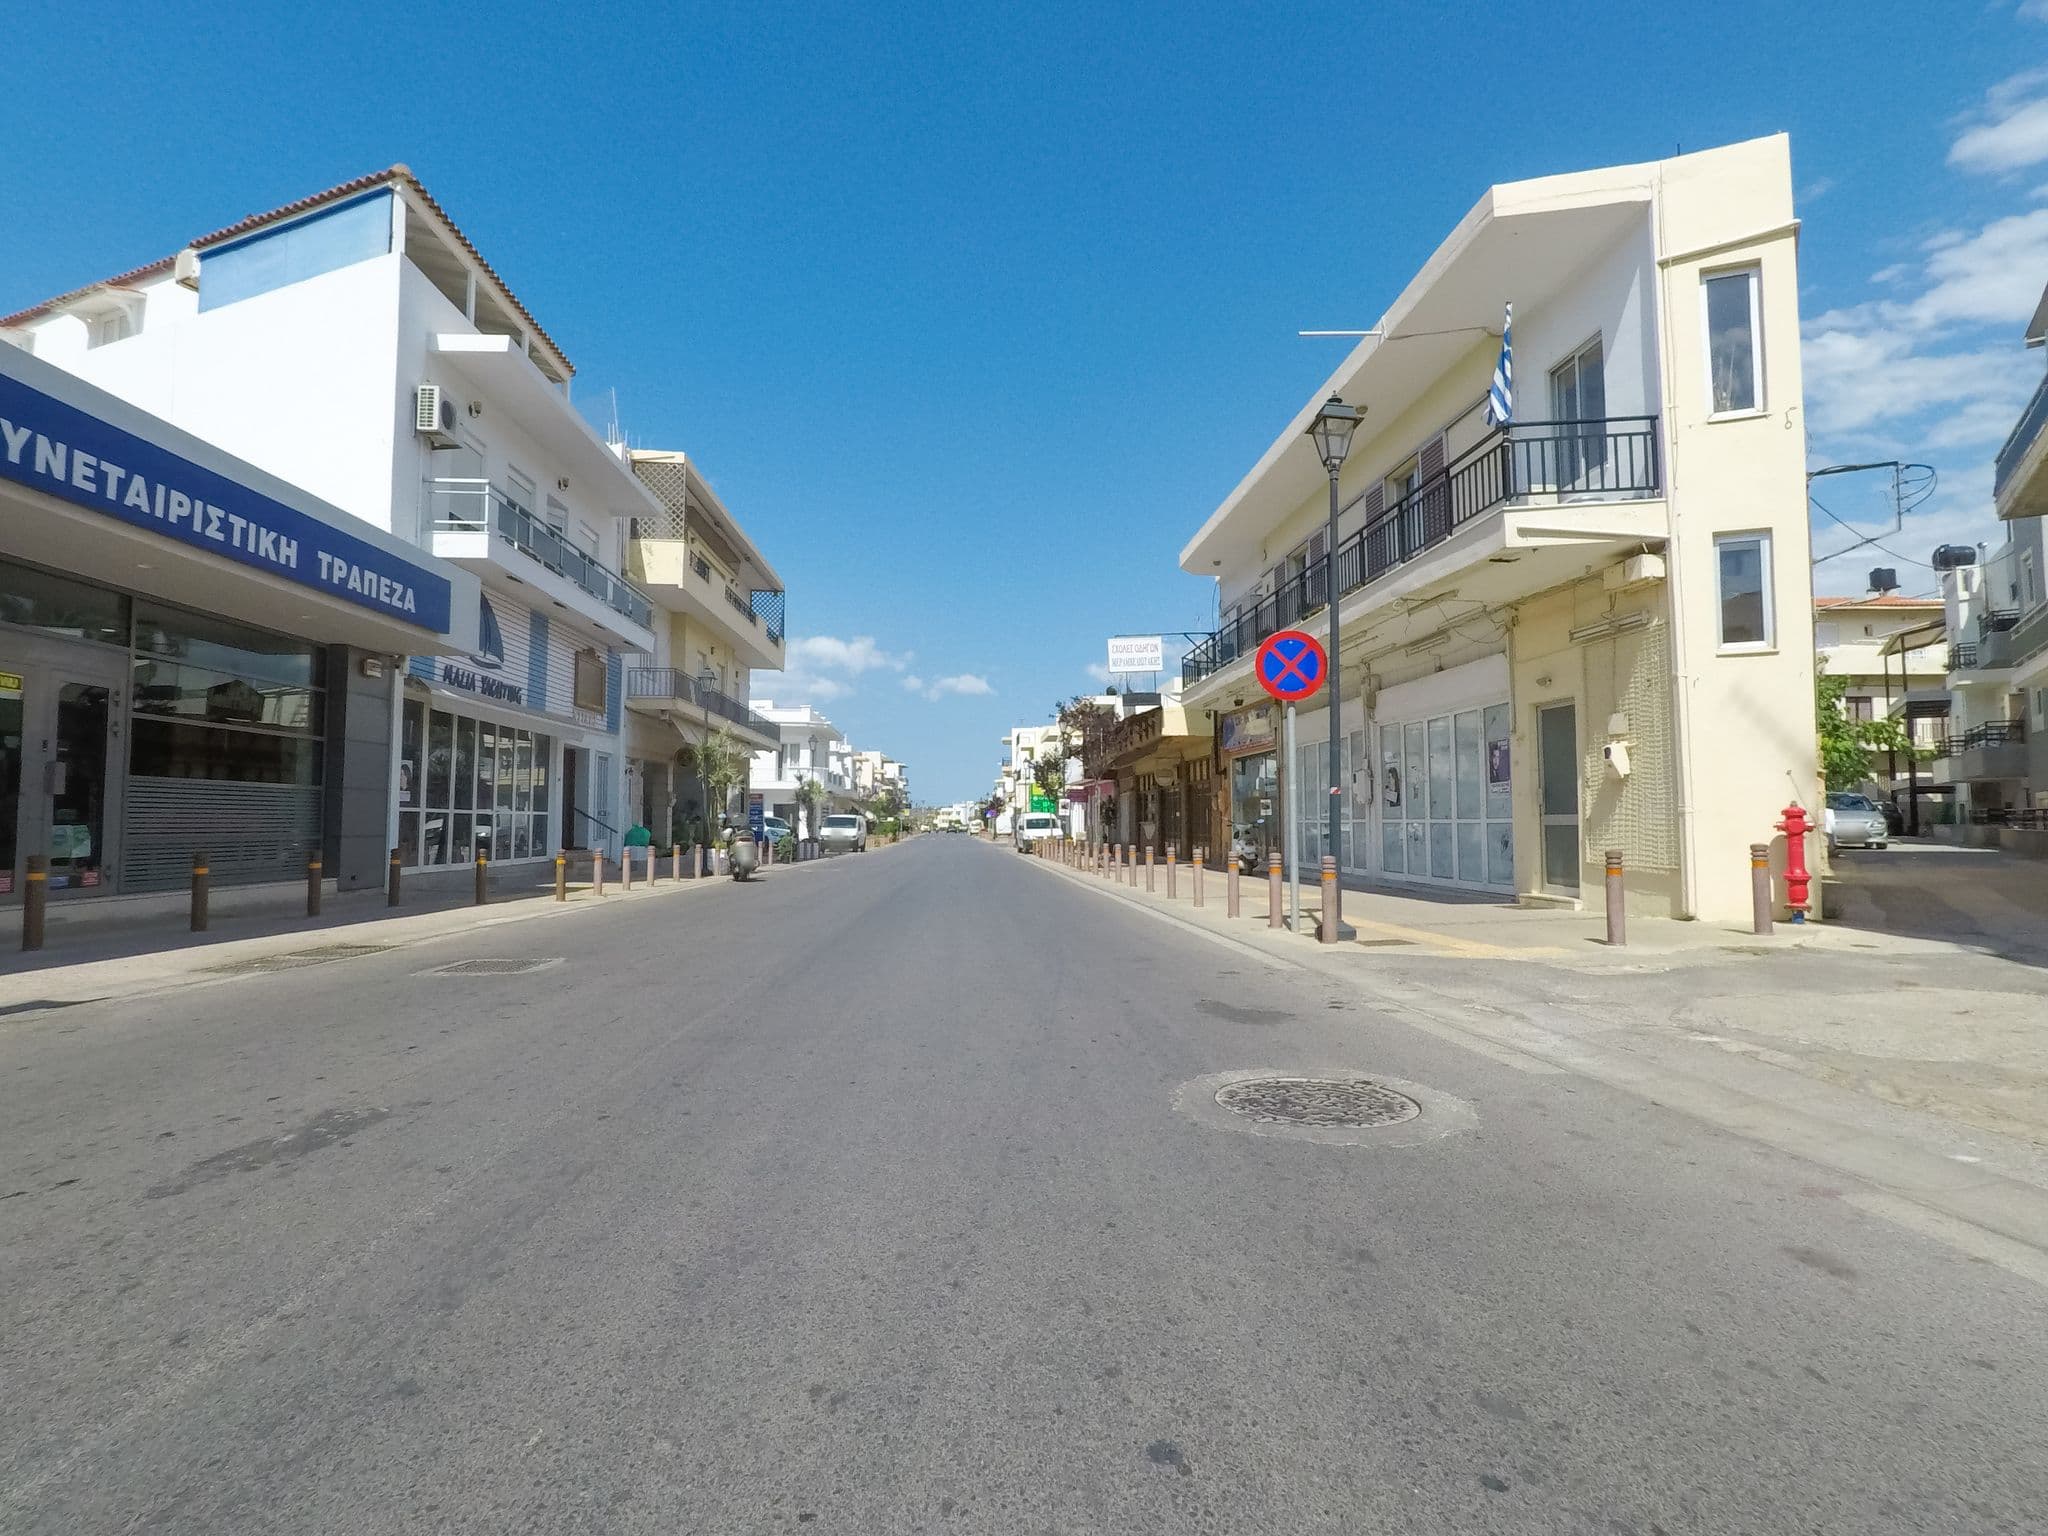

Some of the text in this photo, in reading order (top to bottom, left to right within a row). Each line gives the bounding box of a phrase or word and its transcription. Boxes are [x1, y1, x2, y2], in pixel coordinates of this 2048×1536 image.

[317, 550, 416, 613] ΤΡΑΠΕΖΑ
[443, 664, 522, 705] MALIA YACHTING
